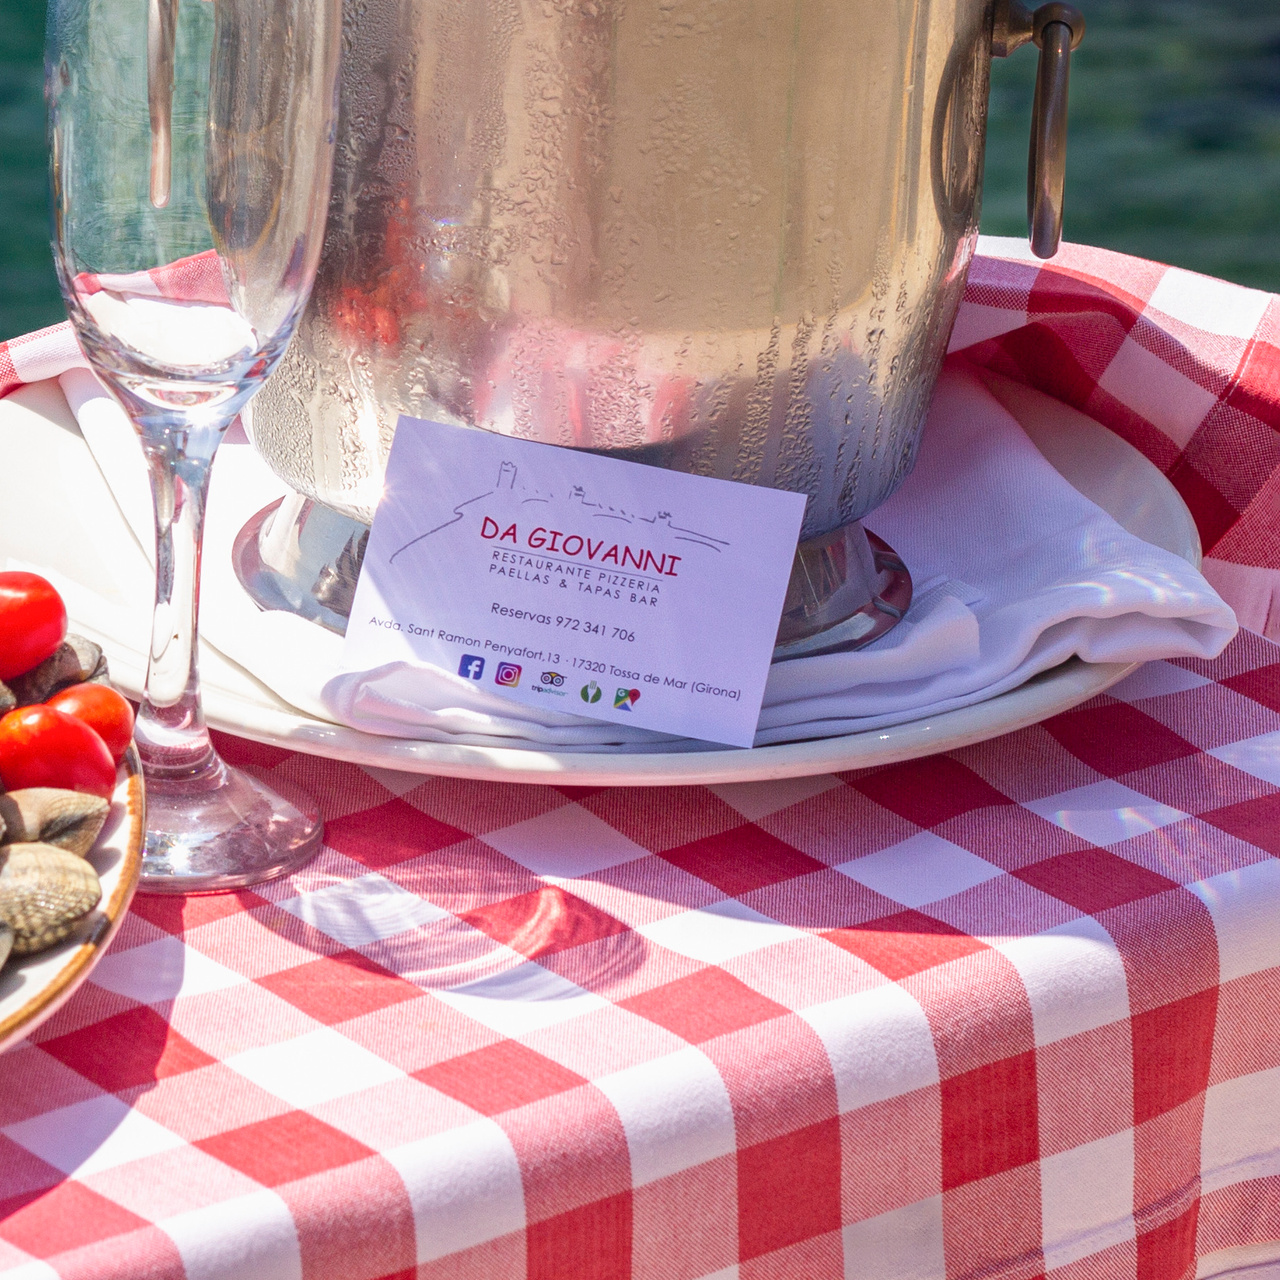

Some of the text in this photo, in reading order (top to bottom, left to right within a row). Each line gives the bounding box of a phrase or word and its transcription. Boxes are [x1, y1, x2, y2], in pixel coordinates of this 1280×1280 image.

[480, 516, 681, 576] DA GIOVANNI
[489, 564, 658, 606] PAELLAS & TAPAS BAR
[492, 550, 660, 593] RESTAURANTE PIZZERIA
[491, 602, 635, 642] Reservas 972 341 706
[369, 616, 404, 632] Avda.
[407, 623, 435, 638] Sant
[438, 630, 481, 647] Ramon
[572, 657, 606, 673] 17320
[609, 665, 640, 680] Tossa
[644, 673, 660, 684] de
[663, 677, 688, 690] Mar
[691, 681, 741, 701] (Girona)
